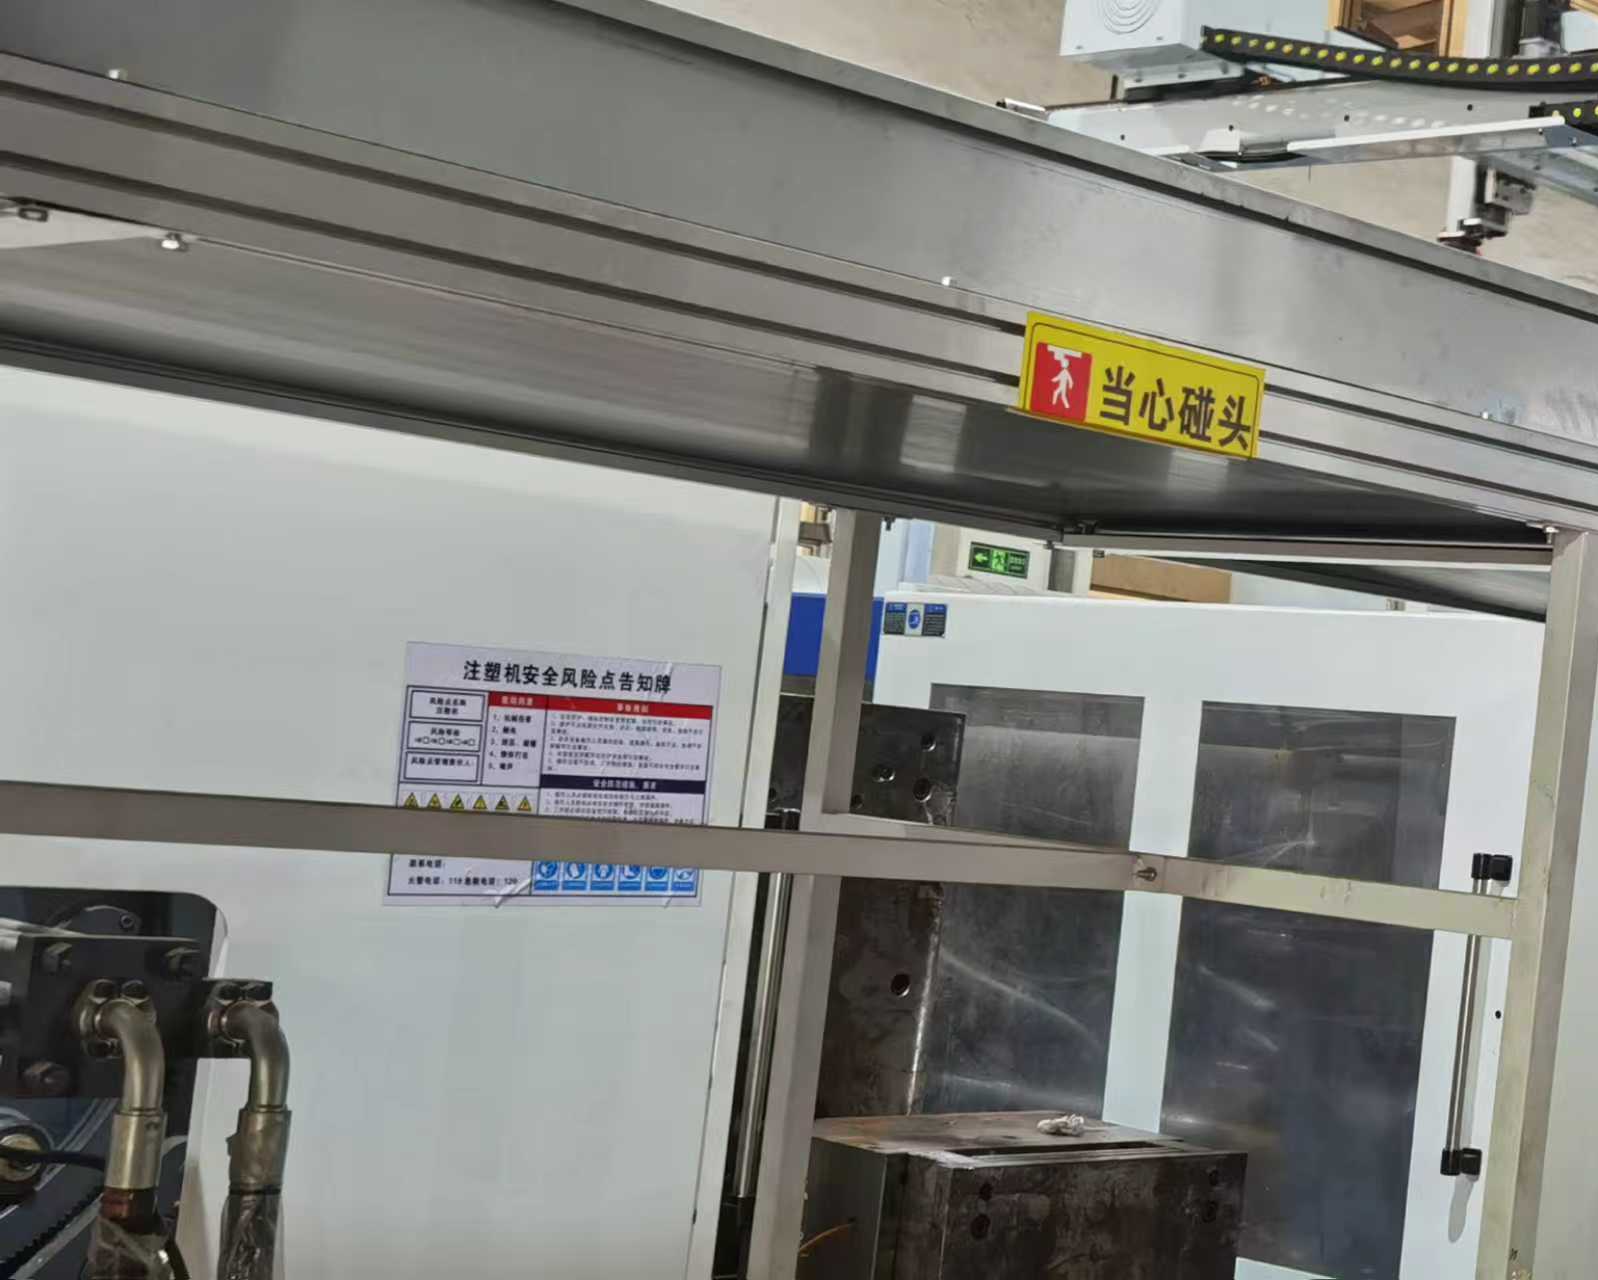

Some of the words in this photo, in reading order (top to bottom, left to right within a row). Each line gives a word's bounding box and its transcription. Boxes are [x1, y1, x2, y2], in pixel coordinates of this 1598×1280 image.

[1099, 365, 1252, 451] 当心碰头
[463, 660, 672, 694] 注塑机安全风险点告知牌
